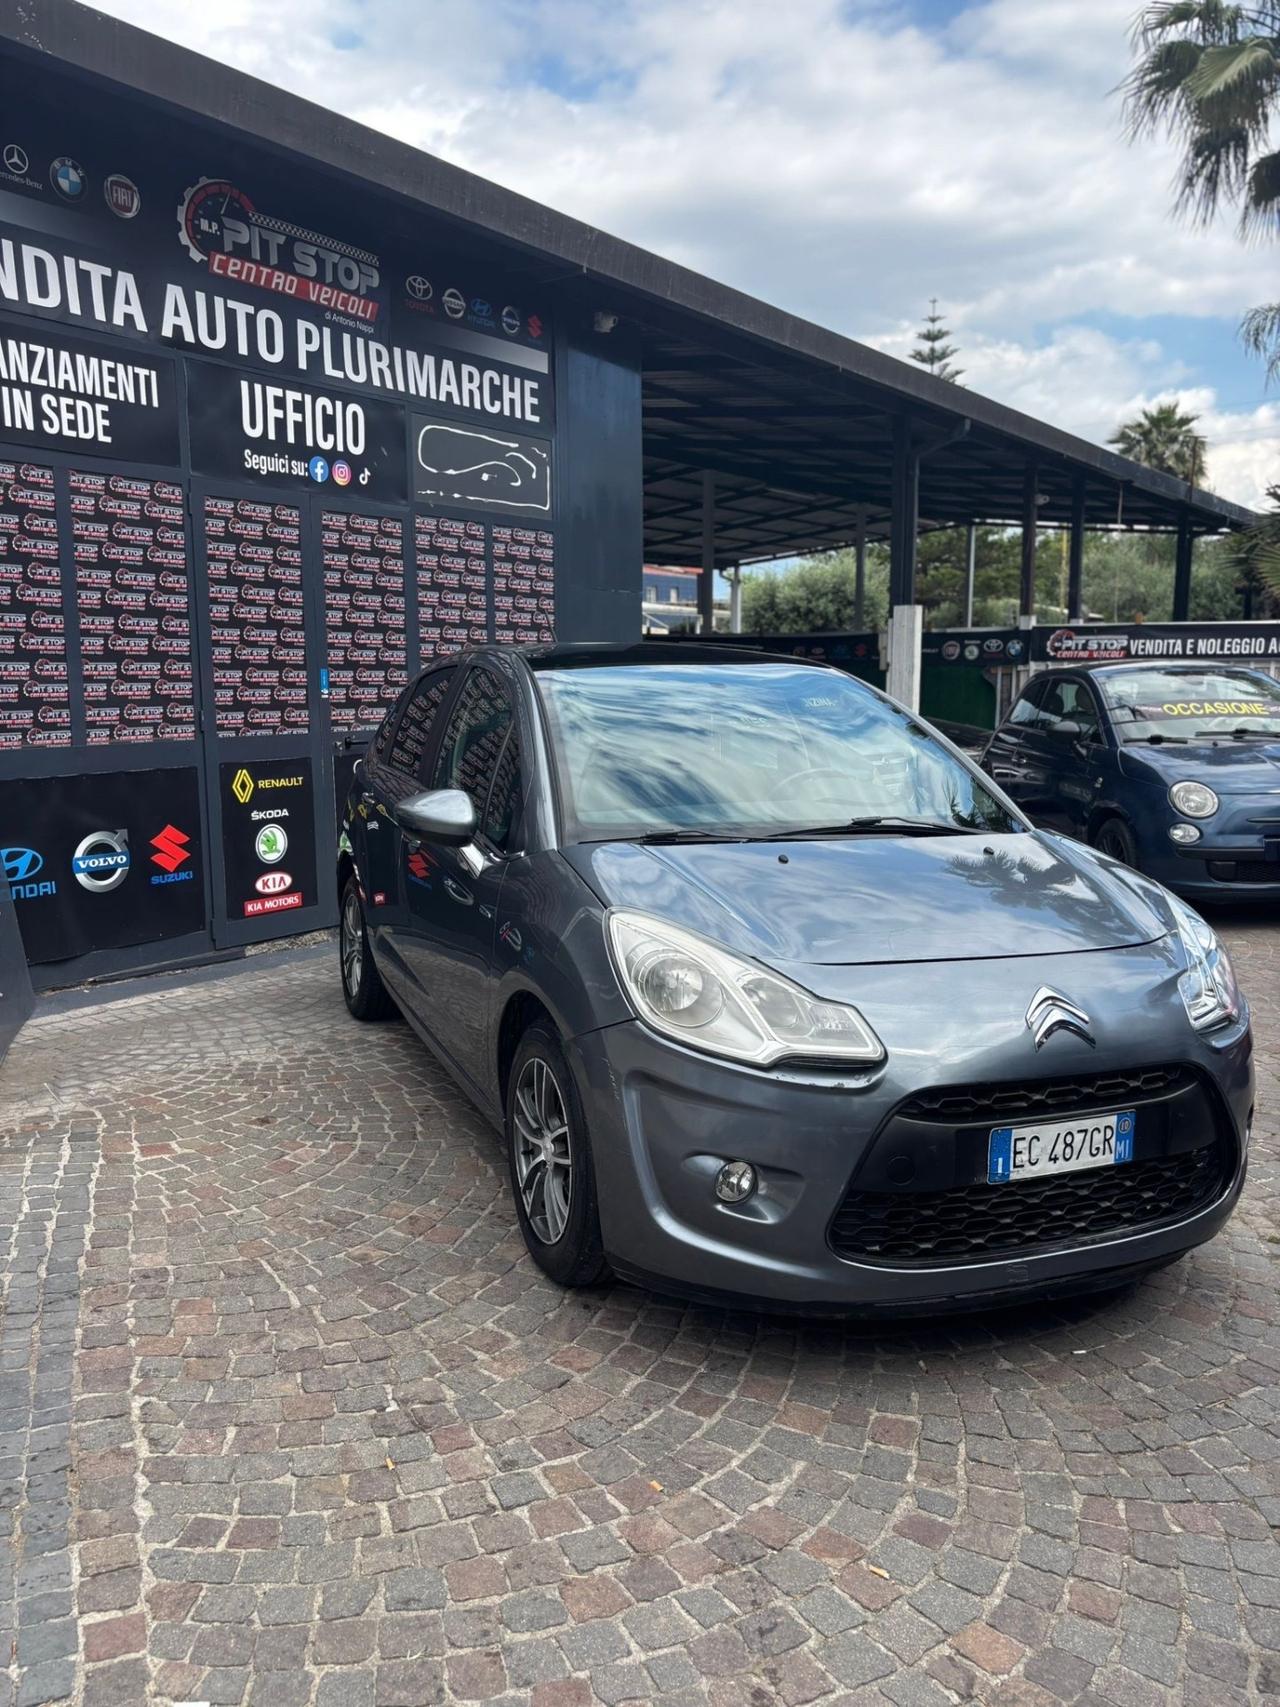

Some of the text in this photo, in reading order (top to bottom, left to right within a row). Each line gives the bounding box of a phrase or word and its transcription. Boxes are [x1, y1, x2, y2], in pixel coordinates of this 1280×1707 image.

[112, 185, 134, 207] FIAT
[200, 219, 221, 235] M.P.
[221, 216, 380, 295] PIT STOP
[332, 313, 356, 328] Antonio
[161, 283, 285, 364] AUTO
[296, 318, 541, 424] PLURIMARCHE
[1, 386, 112, 443] IN SEDE
[240, 380, 366, 456] UFFICIO
[244, 449, 289, 475] Seguici
[291, 460, 309, 477] su:
[1062, 639, 1129, 650] PIT STOP
[1130, 638, 1183, 655] VENDITA
[1186, 638, 1195, 655] E
[1197, 637, 1265, 655] NOLEGGIO
[1162, 702, 1270, 715] OCCASIONE
[258, 776, 304, 789] RENAULT
[251, 808, 289, 821] ŠKODA
[77, 854, 127, 870] VOLVO
[150, 870, 193, 886] SUZUKI
[262, 876, 287, 890] KIA
[11, 880, 56, 900] NDAI
[248, 894, 299, 913] KIA MOTORS
[1012, 1125, 1115, 1169] EC 487GR
[1116, 1139, 1130, 1159] MI
[997, 1157, 1003, 1174] I
